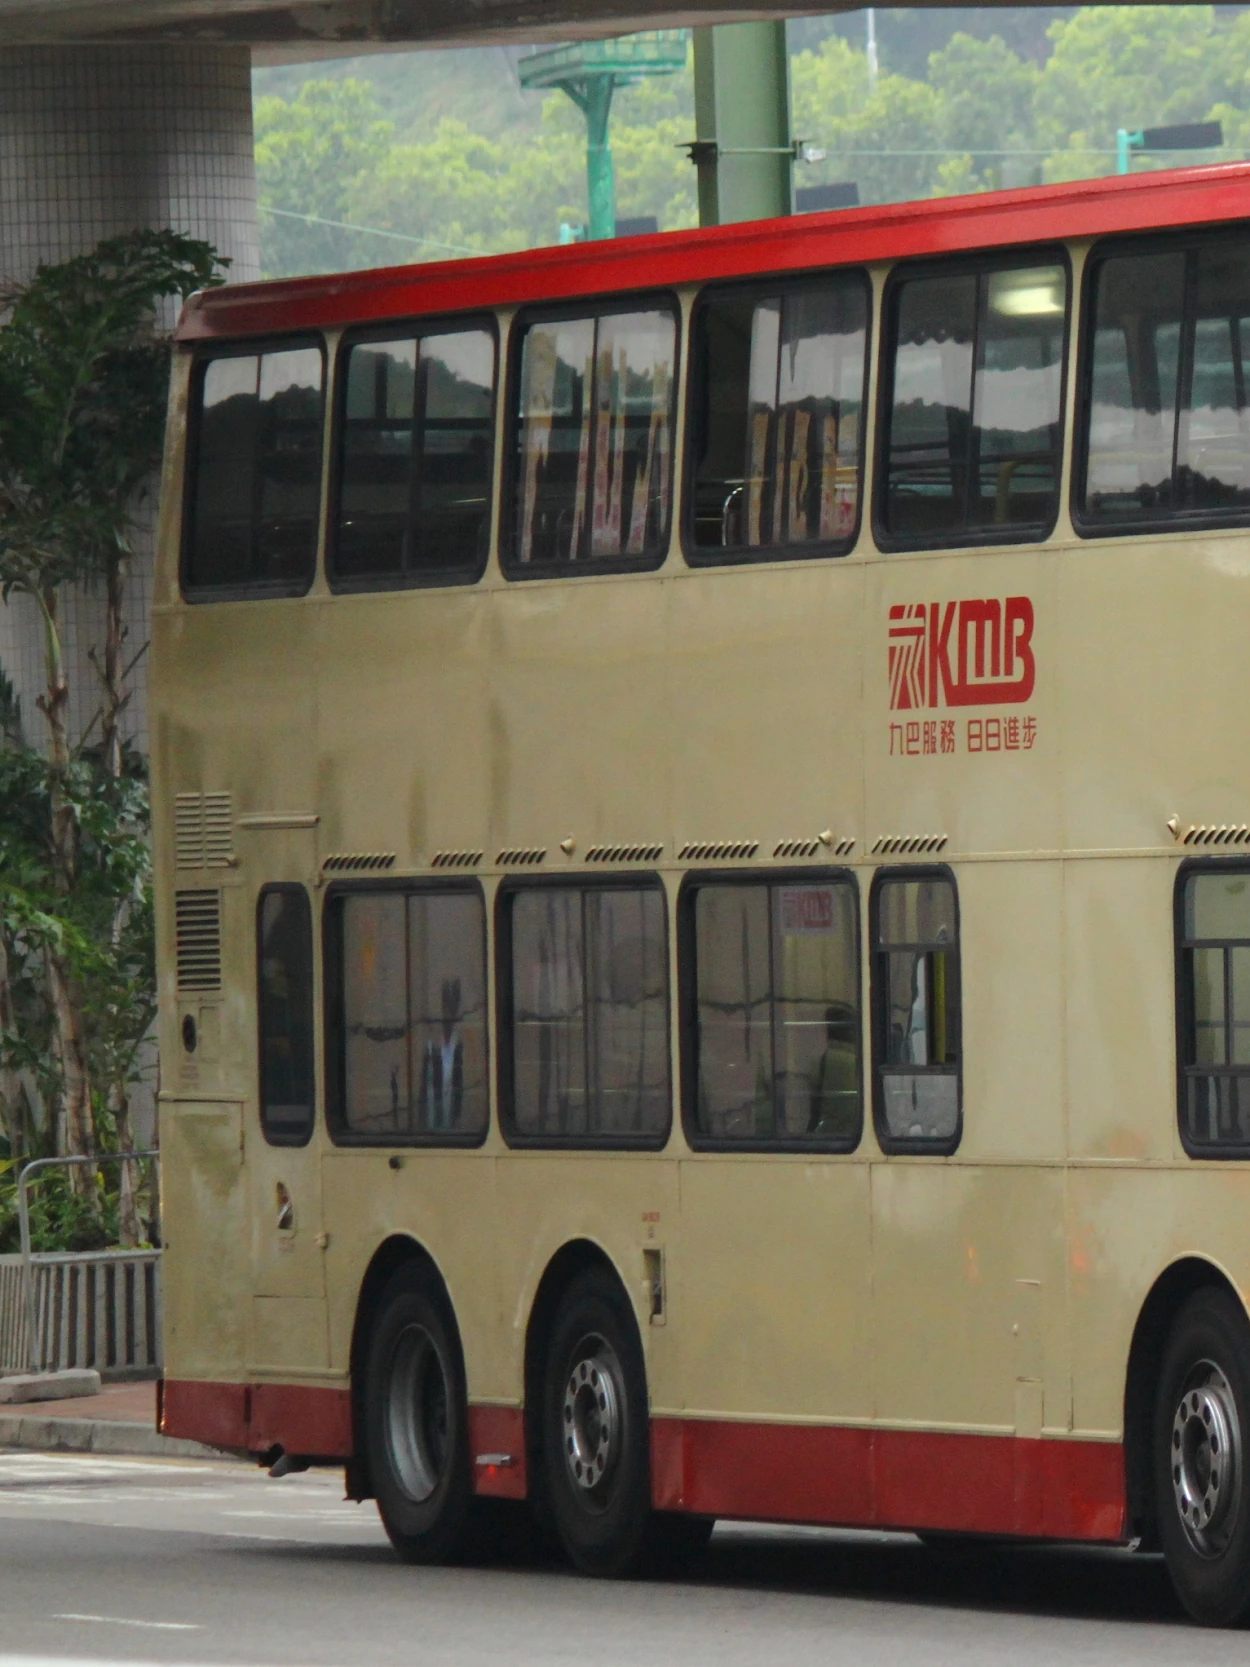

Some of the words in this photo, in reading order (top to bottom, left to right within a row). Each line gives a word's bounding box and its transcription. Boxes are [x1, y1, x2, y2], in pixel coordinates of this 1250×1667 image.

[889, 719, 955, 757] 九巴服務
[967, 715, 1037, 753] 日日進步
